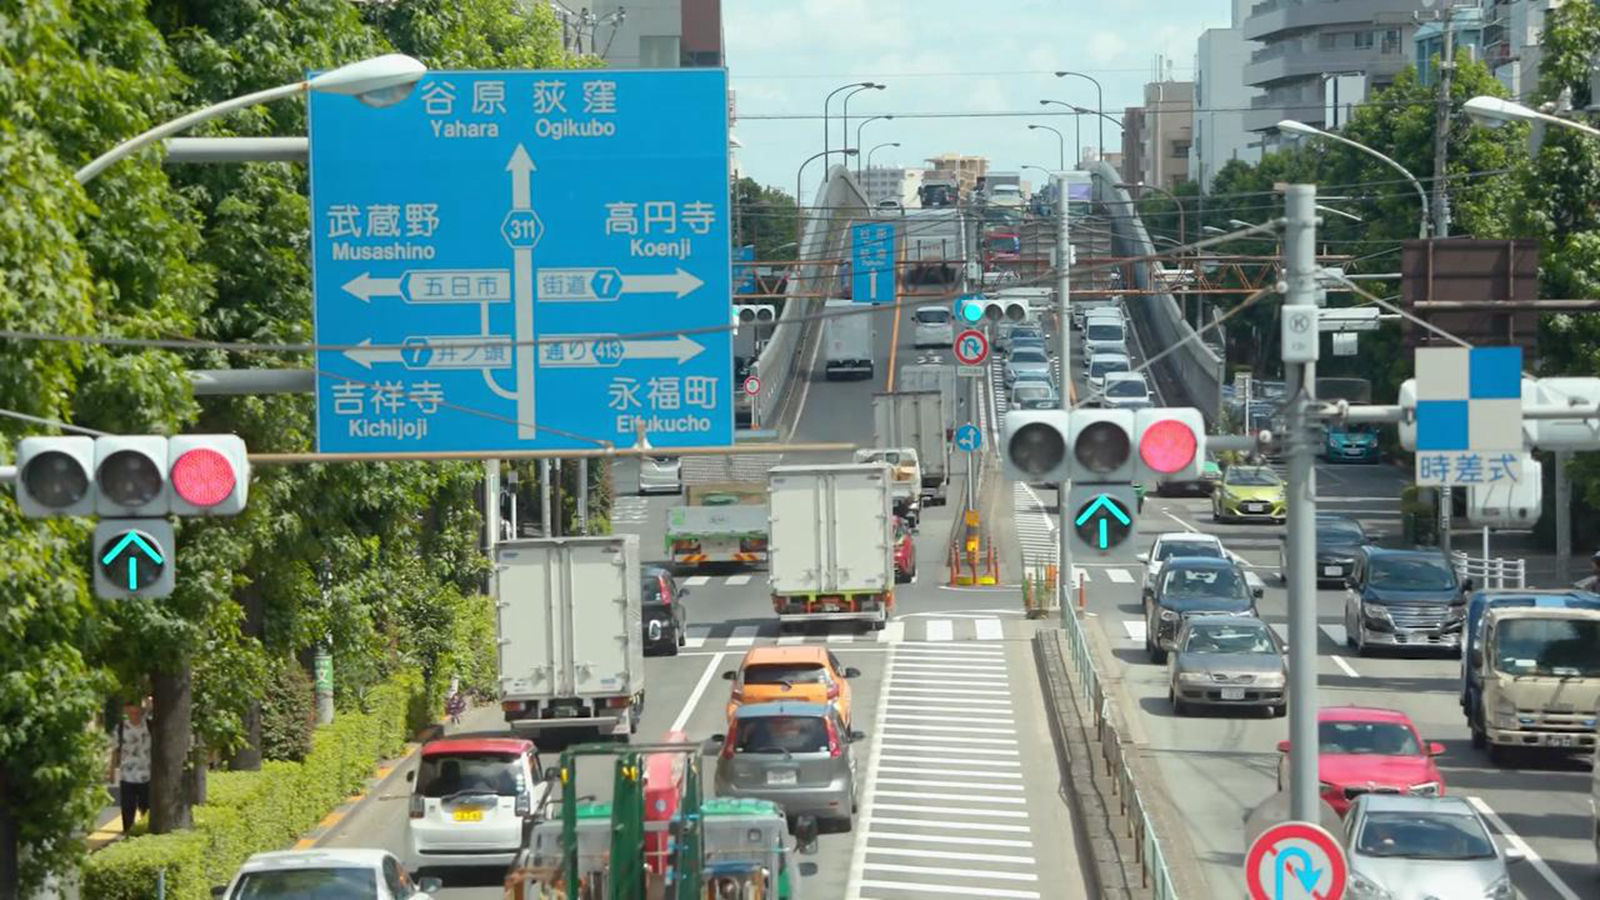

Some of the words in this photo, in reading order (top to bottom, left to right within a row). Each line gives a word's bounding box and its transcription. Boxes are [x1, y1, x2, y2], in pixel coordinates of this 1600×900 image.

[421, 80, 506, 115] 谷原
[533, 80, 617, 115] 荻窪
[431, 120, 499, 138] Yahara
[535, 119, 616, 140] Ogikubo
[327, 203, 441, 238] 武蔵野
[510, 219, 536, 240] 311
[604, 201, 717, 235] 高円寺
[332, 243, 436, 260] Musashino
[630, 240, 692, 259] Koenji
[424, 276, 499, 297] 五日市
[543, 275, 586, 296] 街道
[600, 274, 613, 294] 7
[410, 342, 422, 363] 7
[436, 341, 505, 361] 井ノ頭
[544, 340, 587, 360] 通り
[595, 342, 621, 358] 413
[332, 380, 445, 415] 吉祥寺
[608, 376, 719, 411] 永福町
[349, 416, 428, 439] Kichijoji
[1420, 454, 1518, 483] 時差式
